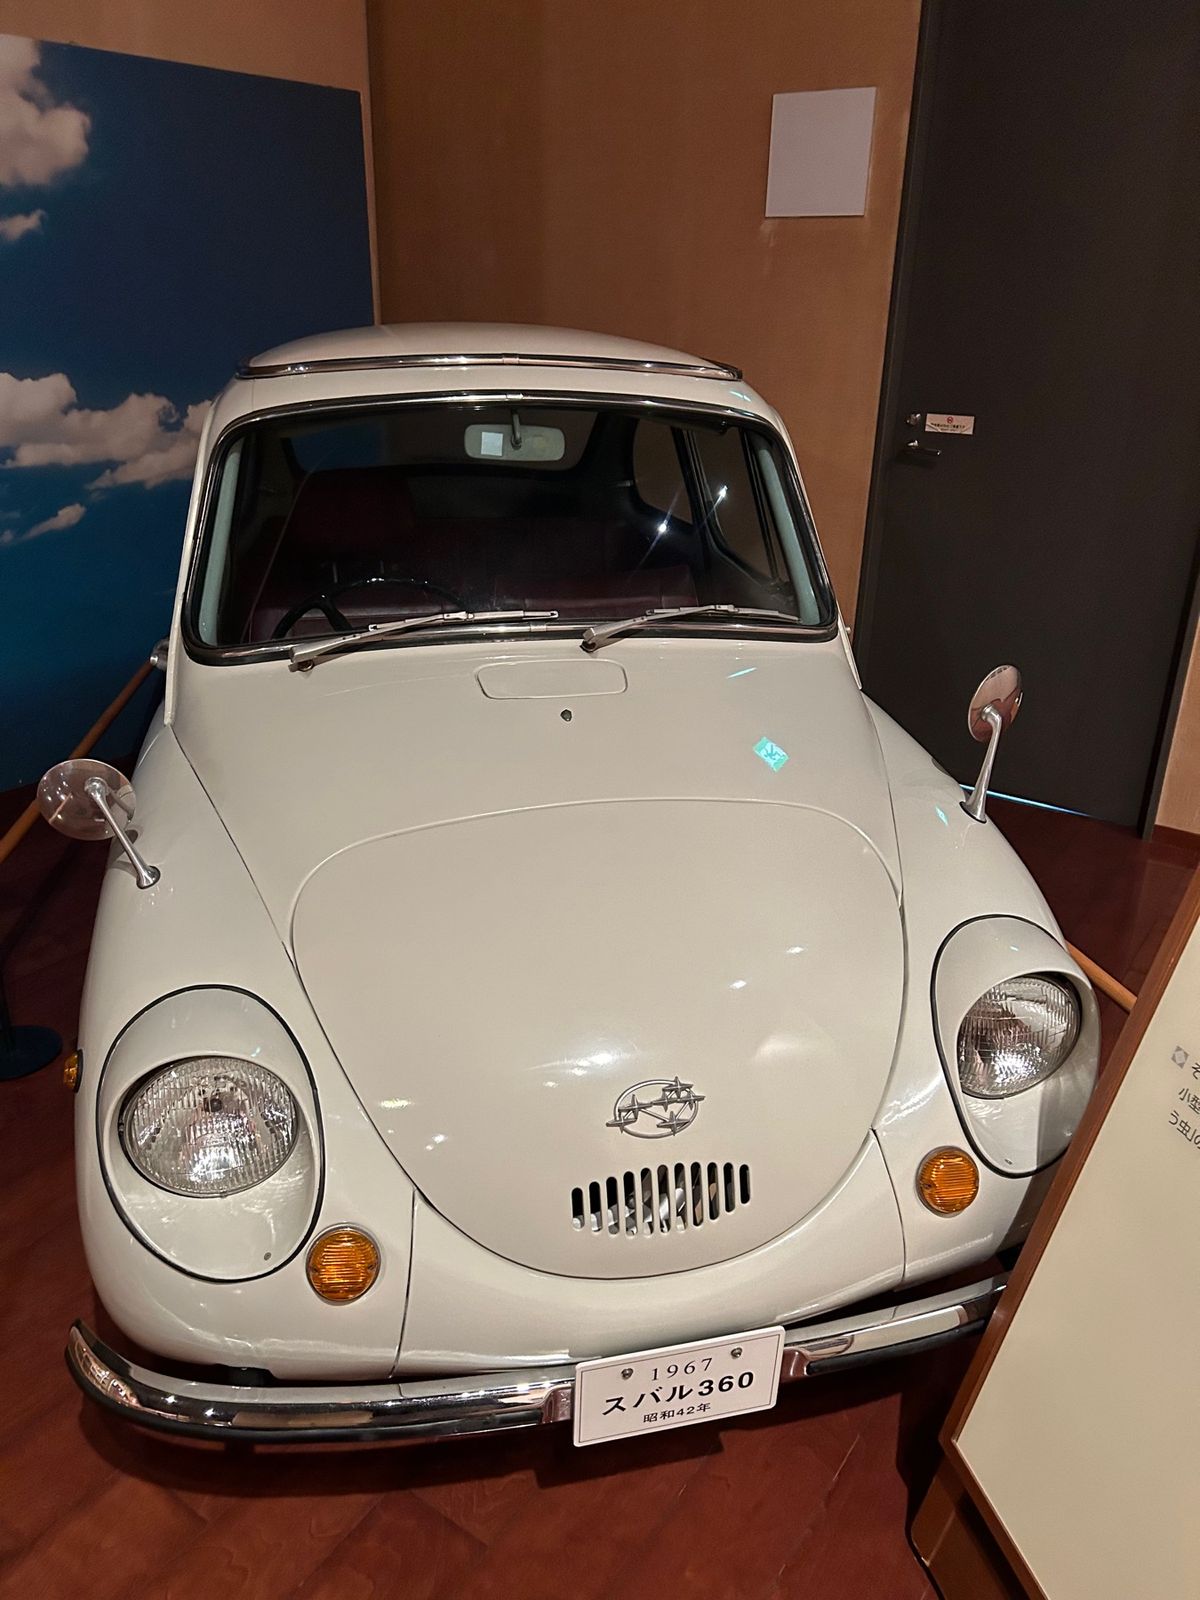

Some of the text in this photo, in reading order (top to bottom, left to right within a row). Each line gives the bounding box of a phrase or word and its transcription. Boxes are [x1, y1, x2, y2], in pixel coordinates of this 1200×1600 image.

[652, 1357, 713, 1381] 1967
[602, 1371, 754, 1416] スバル360
[643, 1402, 711, 1423] 昭和42年
